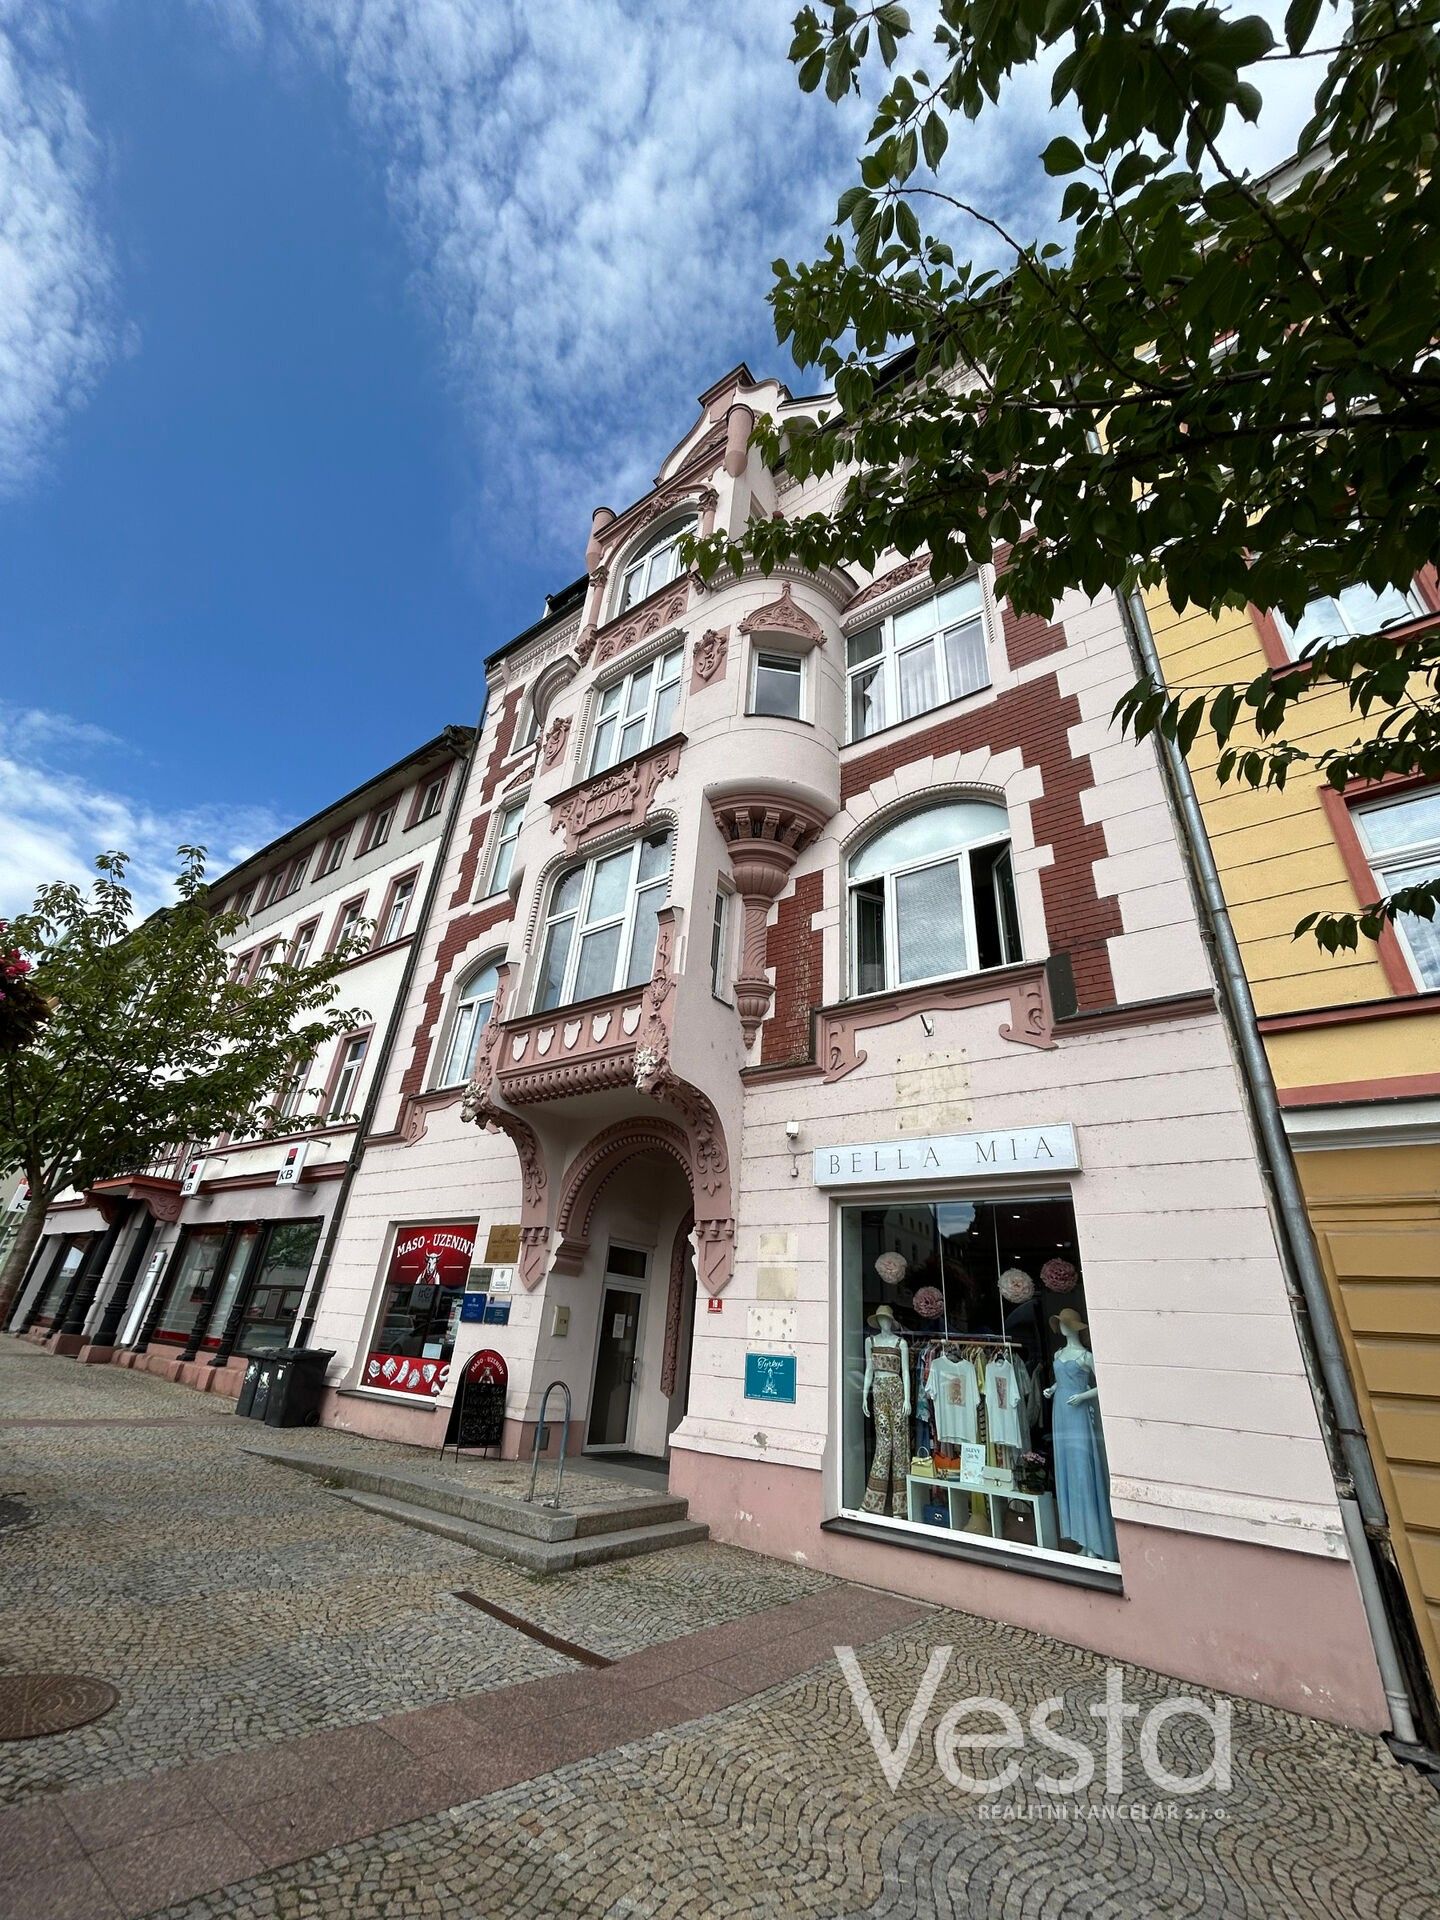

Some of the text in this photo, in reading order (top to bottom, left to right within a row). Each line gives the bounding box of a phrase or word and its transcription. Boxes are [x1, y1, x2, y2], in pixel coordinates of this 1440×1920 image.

[829, 1135, 1055, 1175] BELLA MIA
[278, 1169, 294, 1180] KB
[396, 1235, 425, 1258] MASO
[470, 1357, 484, 1373] MASO
[486, 1356, 505, 1375] UZENINY
